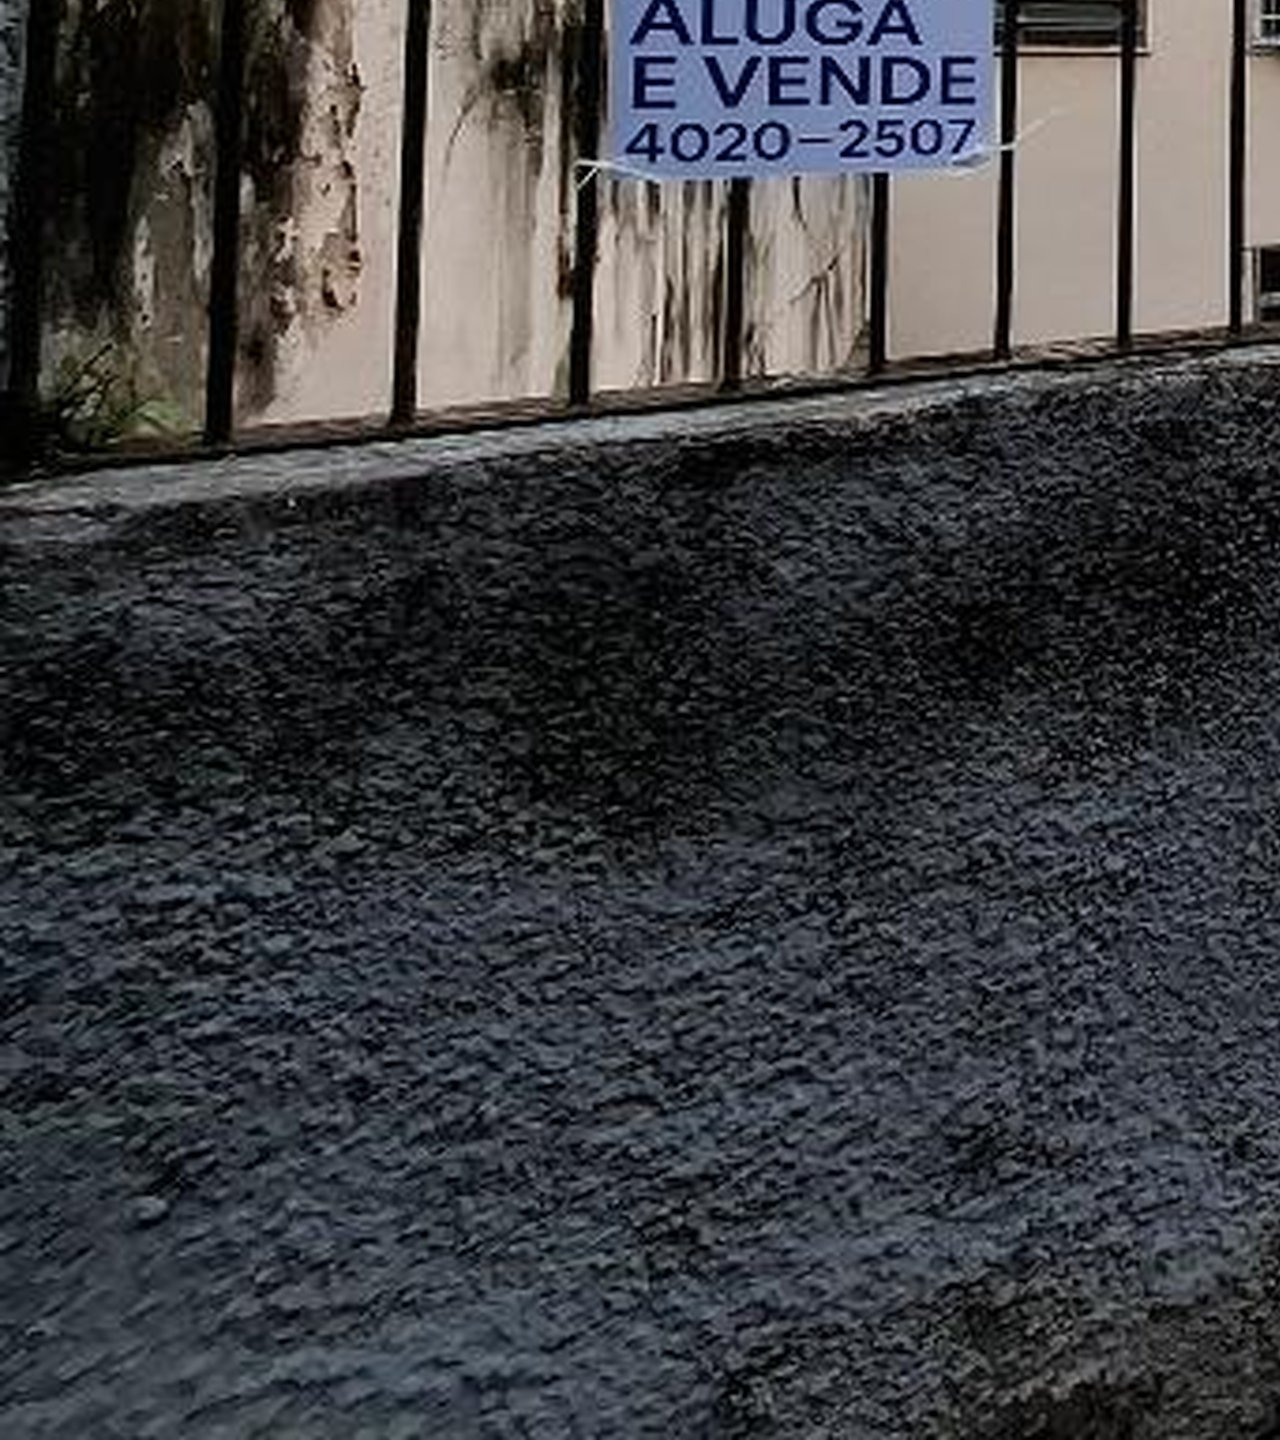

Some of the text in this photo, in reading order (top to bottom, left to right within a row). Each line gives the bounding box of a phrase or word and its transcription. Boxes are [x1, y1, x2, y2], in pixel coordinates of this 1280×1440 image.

[632, 55, 976, 109] E VENDE
[625, 118, 976, 162] 4020-2507
